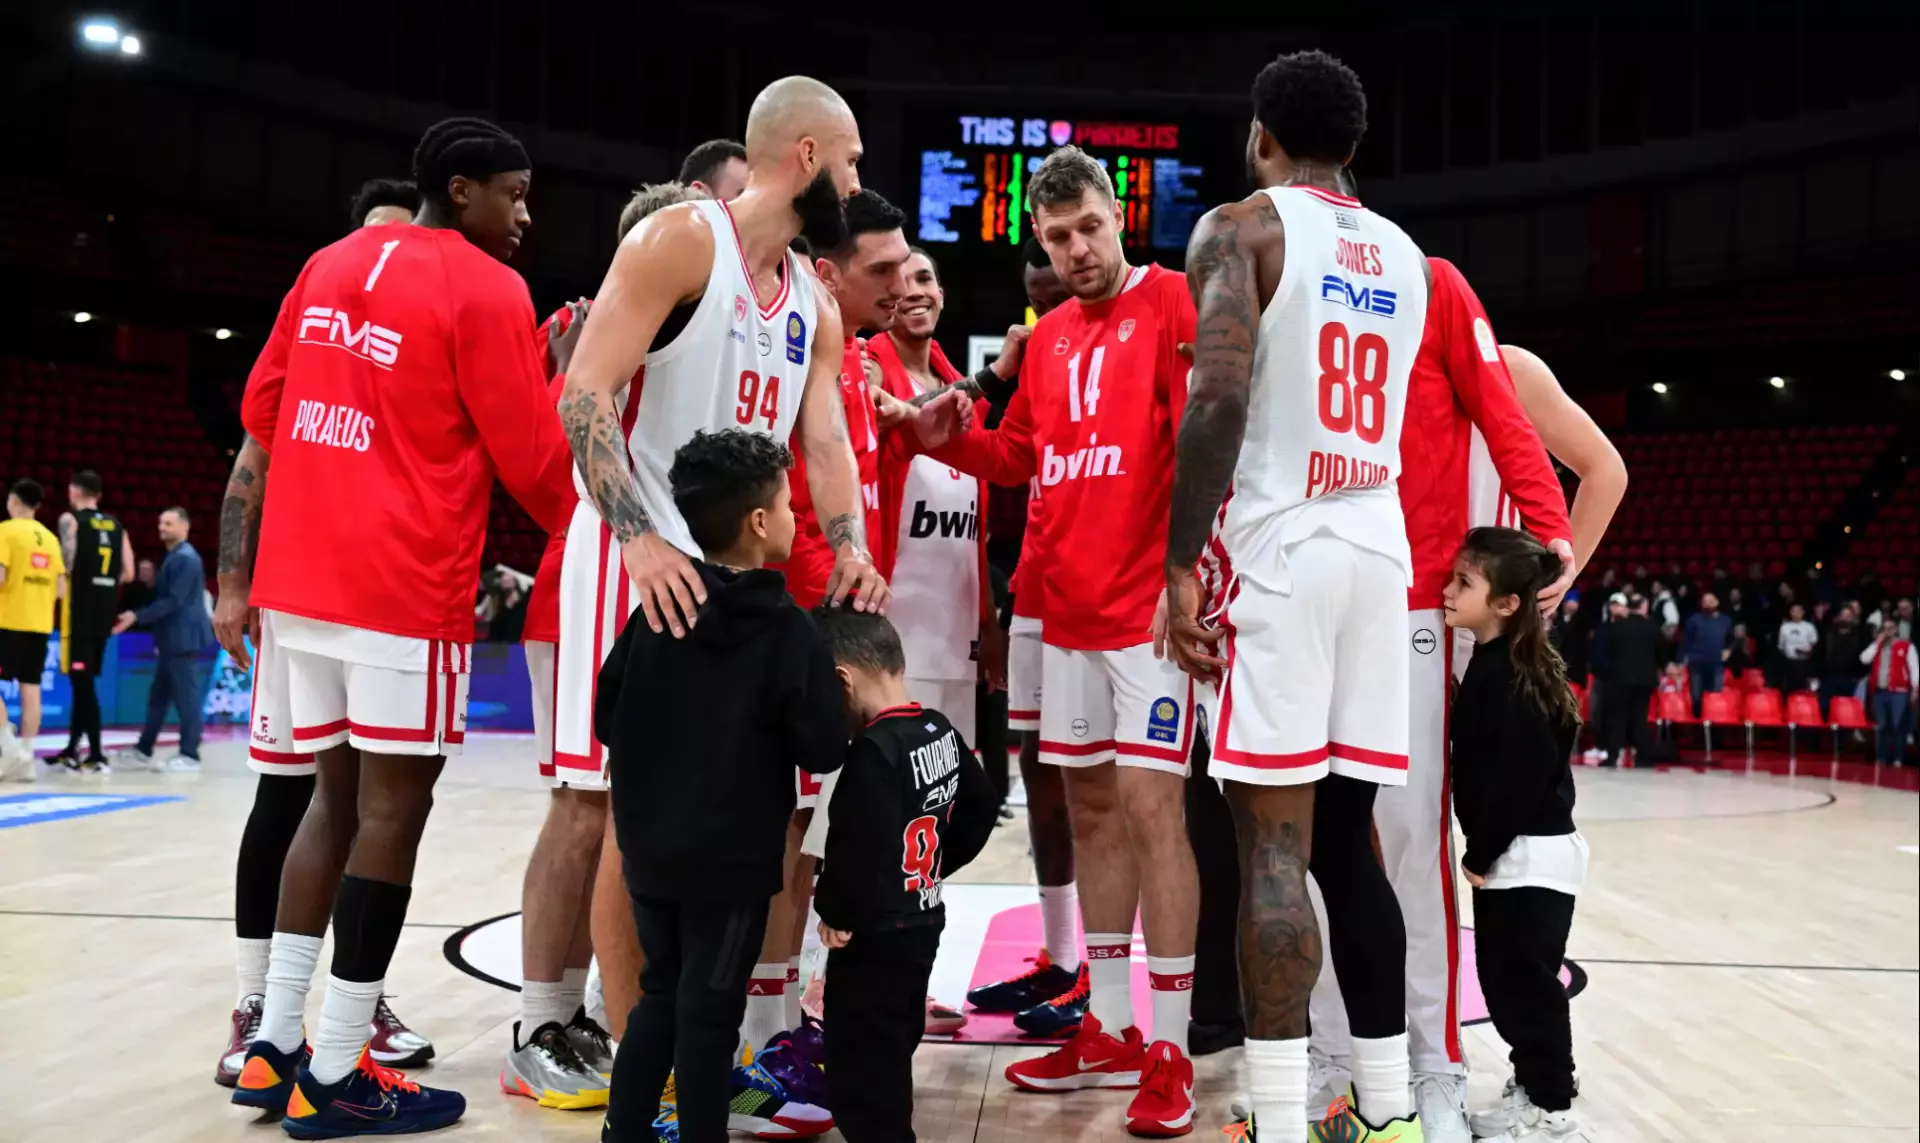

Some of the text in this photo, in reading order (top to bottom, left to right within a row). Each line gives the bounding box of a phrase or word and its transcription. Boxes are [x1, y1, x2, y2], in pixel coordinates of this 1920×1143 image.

[959, 116, 1015, 146] THIS
[1021, 118, 1047, 147] IS
[364, 240, 400, 292] 1
[1335, 237, 1383, 277] JONES
[1322, 274, 1397, 315] FMS
[299, 306, 403, 366] FMS
[736, 370, 780, 431] 94
[1068, 346, 1106, 423] 14
[1318, 321, 1389, 444] 88
[291, 400, 375, 452] PIRAEUS
[98, 547, 112, 576] 7
[1087, 947, 1125, 959] GSA
